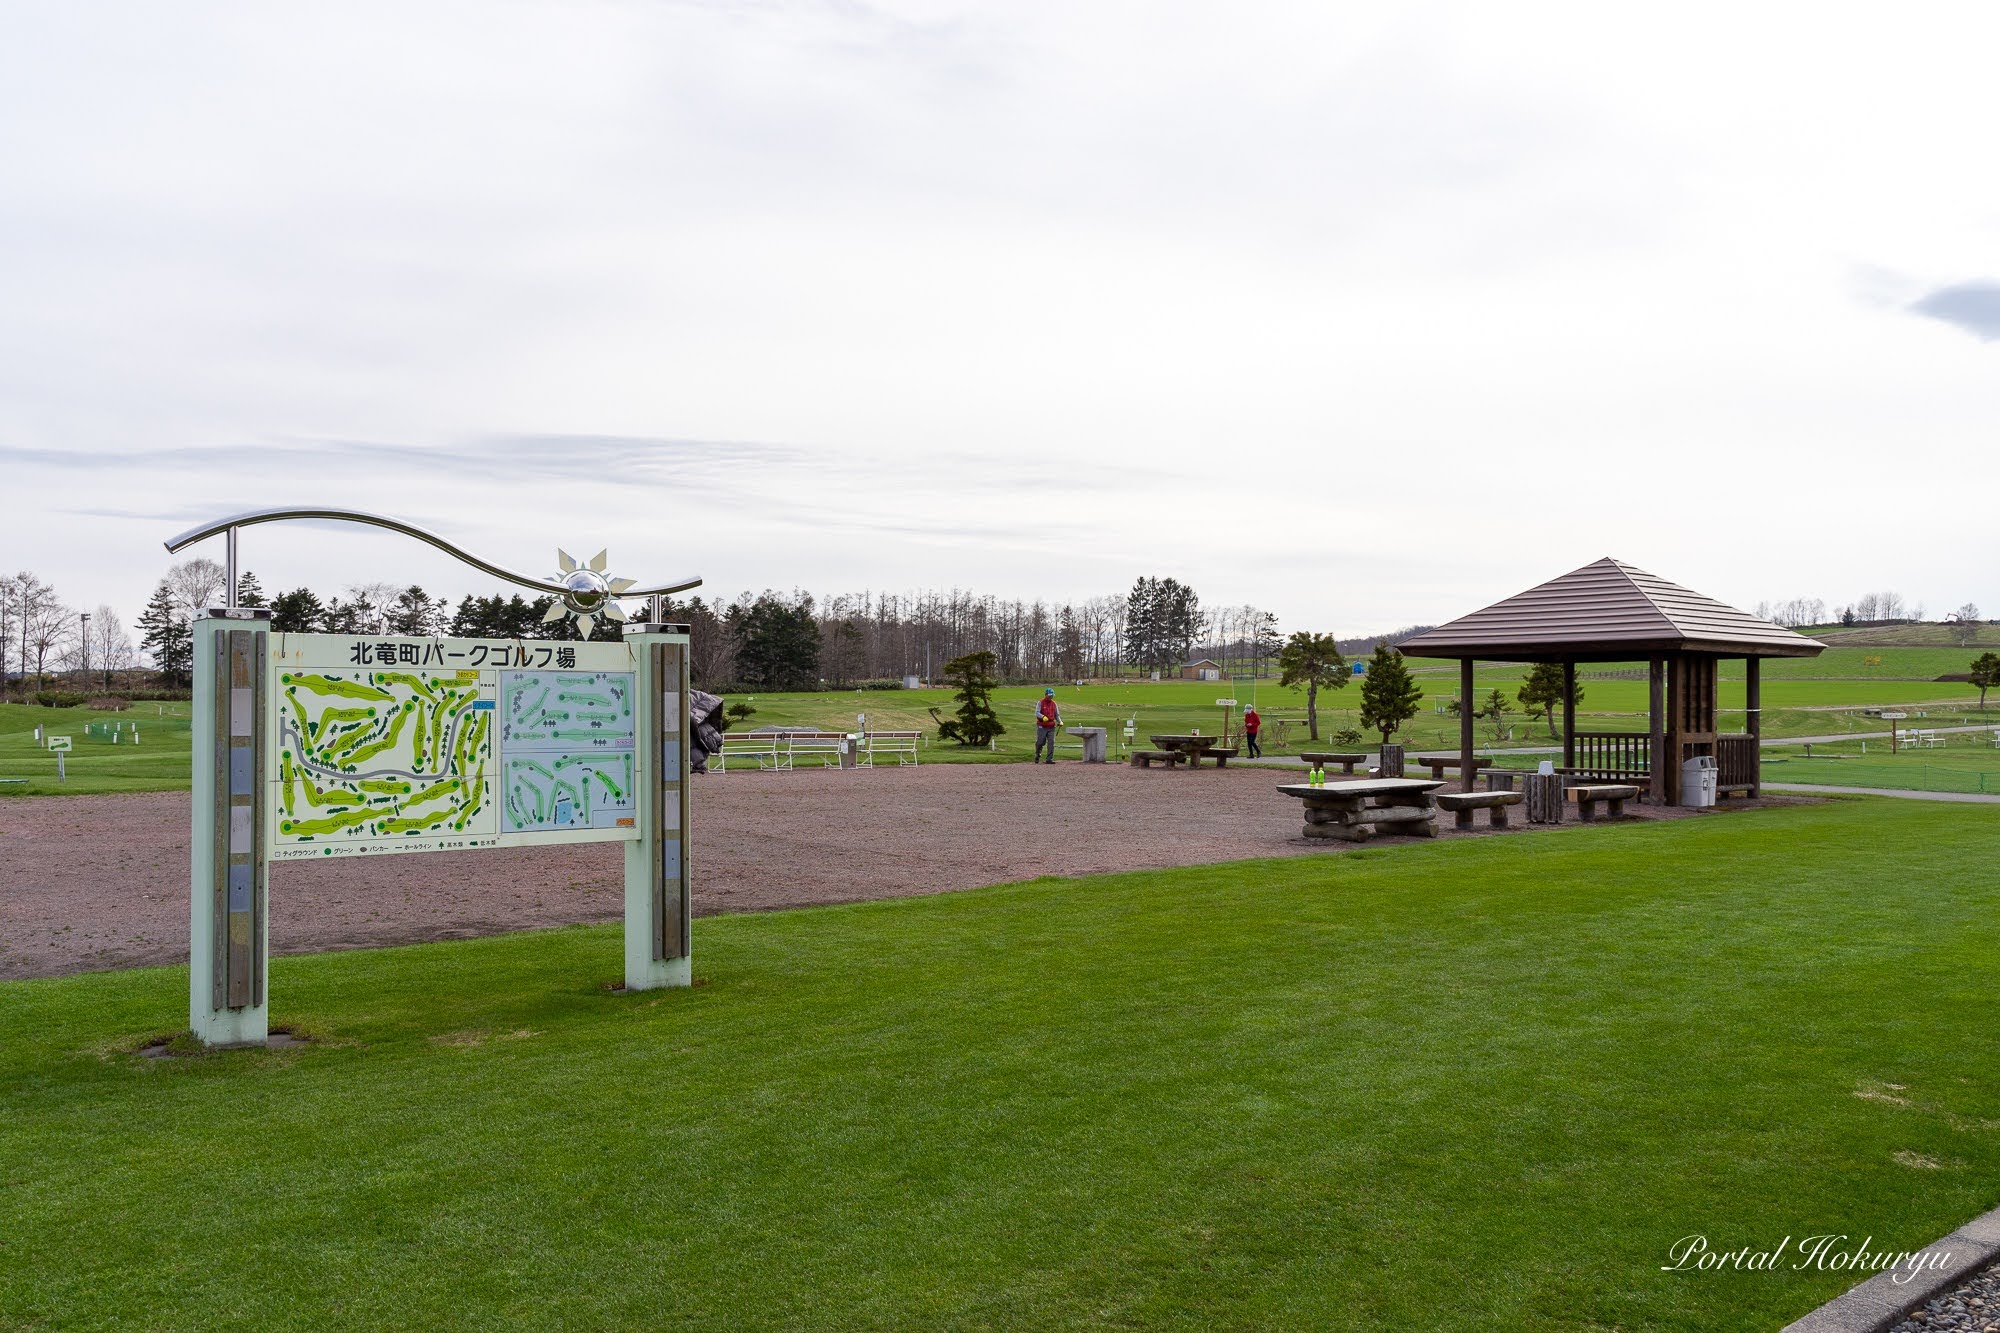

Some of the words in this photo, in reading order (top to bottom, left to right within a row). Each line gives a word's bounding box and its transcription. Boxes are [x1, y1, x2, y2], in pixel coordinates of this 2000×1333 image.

[349, 641, 576, 669] 北竜町パークゴルフ場
[334, 847, 354, 855] グリーン
